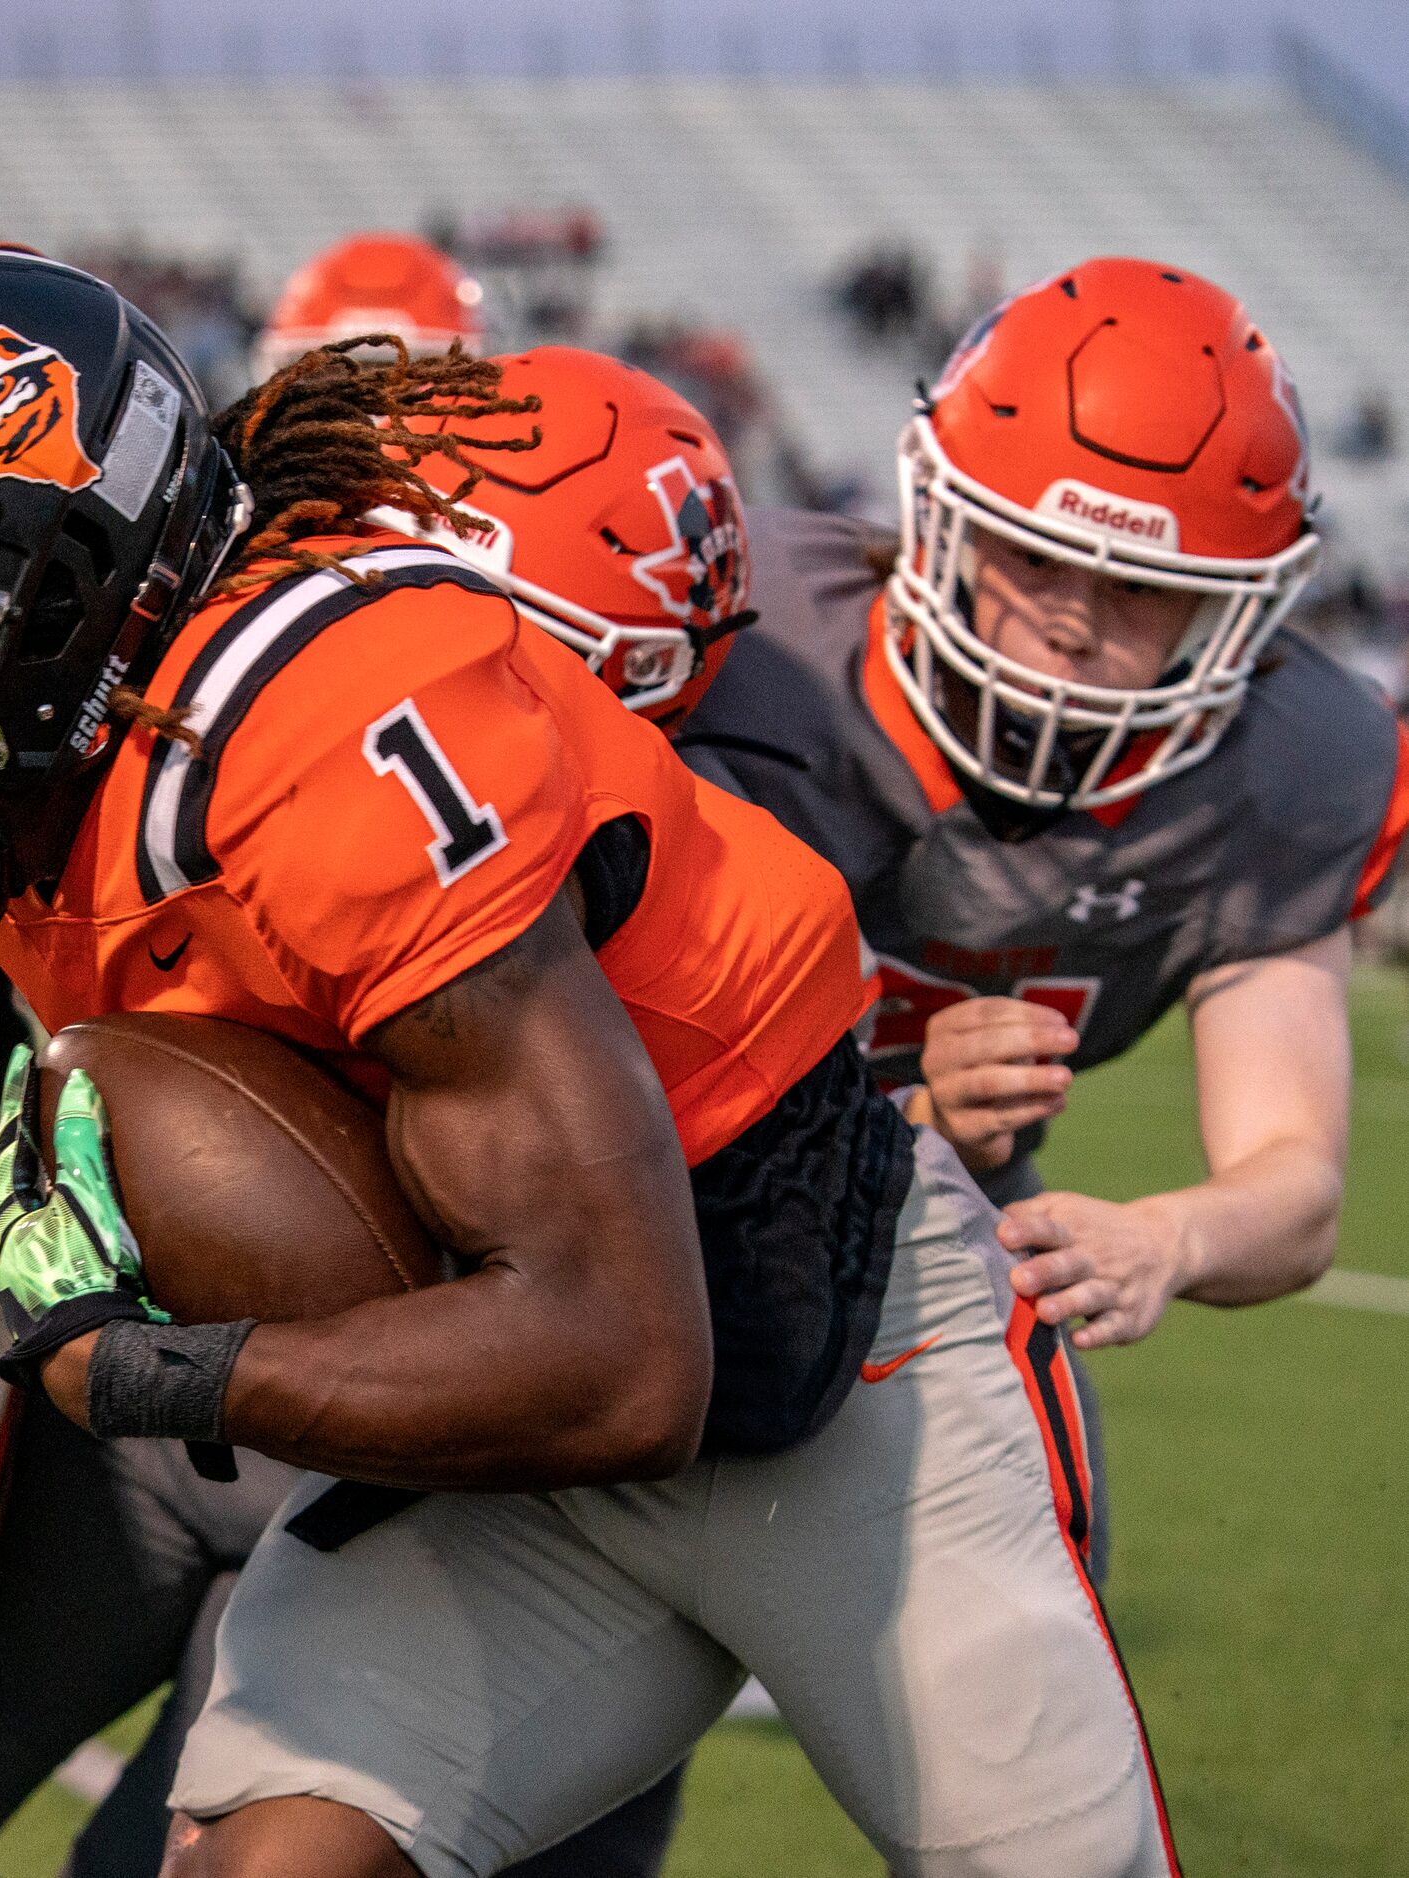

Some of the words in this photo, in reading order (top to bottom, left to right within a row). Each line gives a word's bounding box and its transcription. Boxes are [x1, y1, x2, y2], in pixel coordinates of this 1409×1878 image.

[1058, 488, 1167, 541] Riddell
[68, 653, 132, 755] schutt
[360, 697, 511, 889] 1
